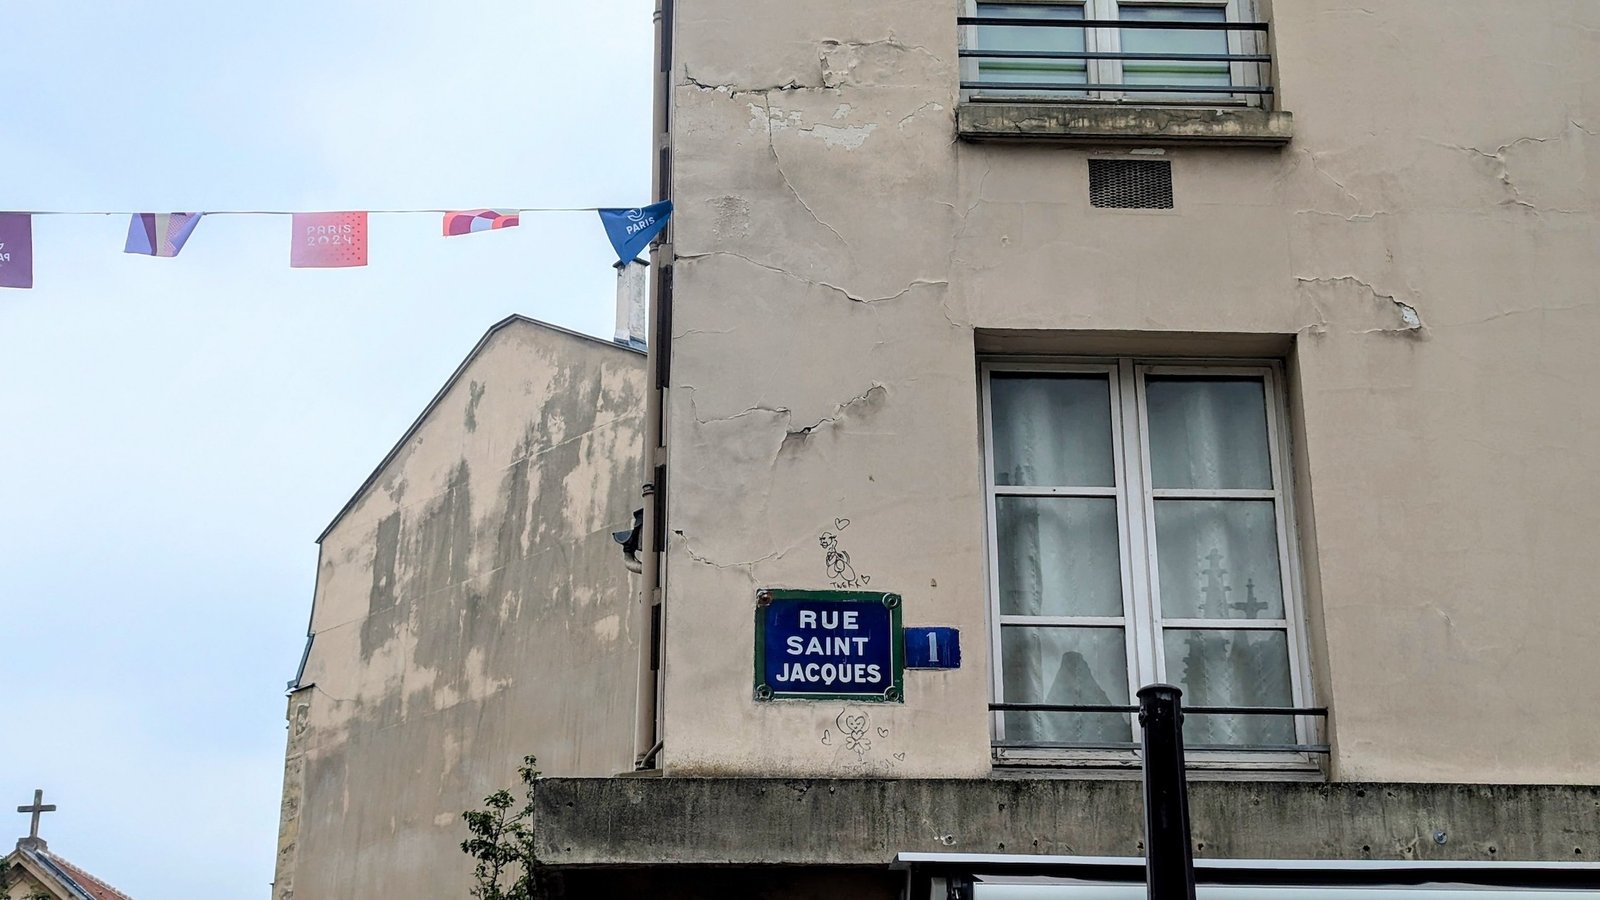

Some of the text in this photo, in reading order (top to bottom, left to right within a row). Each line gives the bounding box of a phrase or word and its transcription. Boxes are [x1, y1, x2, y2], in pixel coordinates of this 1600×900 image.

[306, 224, 351, 235] PARIS
[626, 216, 655, 235] PARIS
[307, 234, 351, 246] 2024
[799, 610, 859, 630] RUE
[786, 636, 869, 656] SAINT
[925, 631, 940, 662] 1
[776, 663, 882, 685] JACQUES
